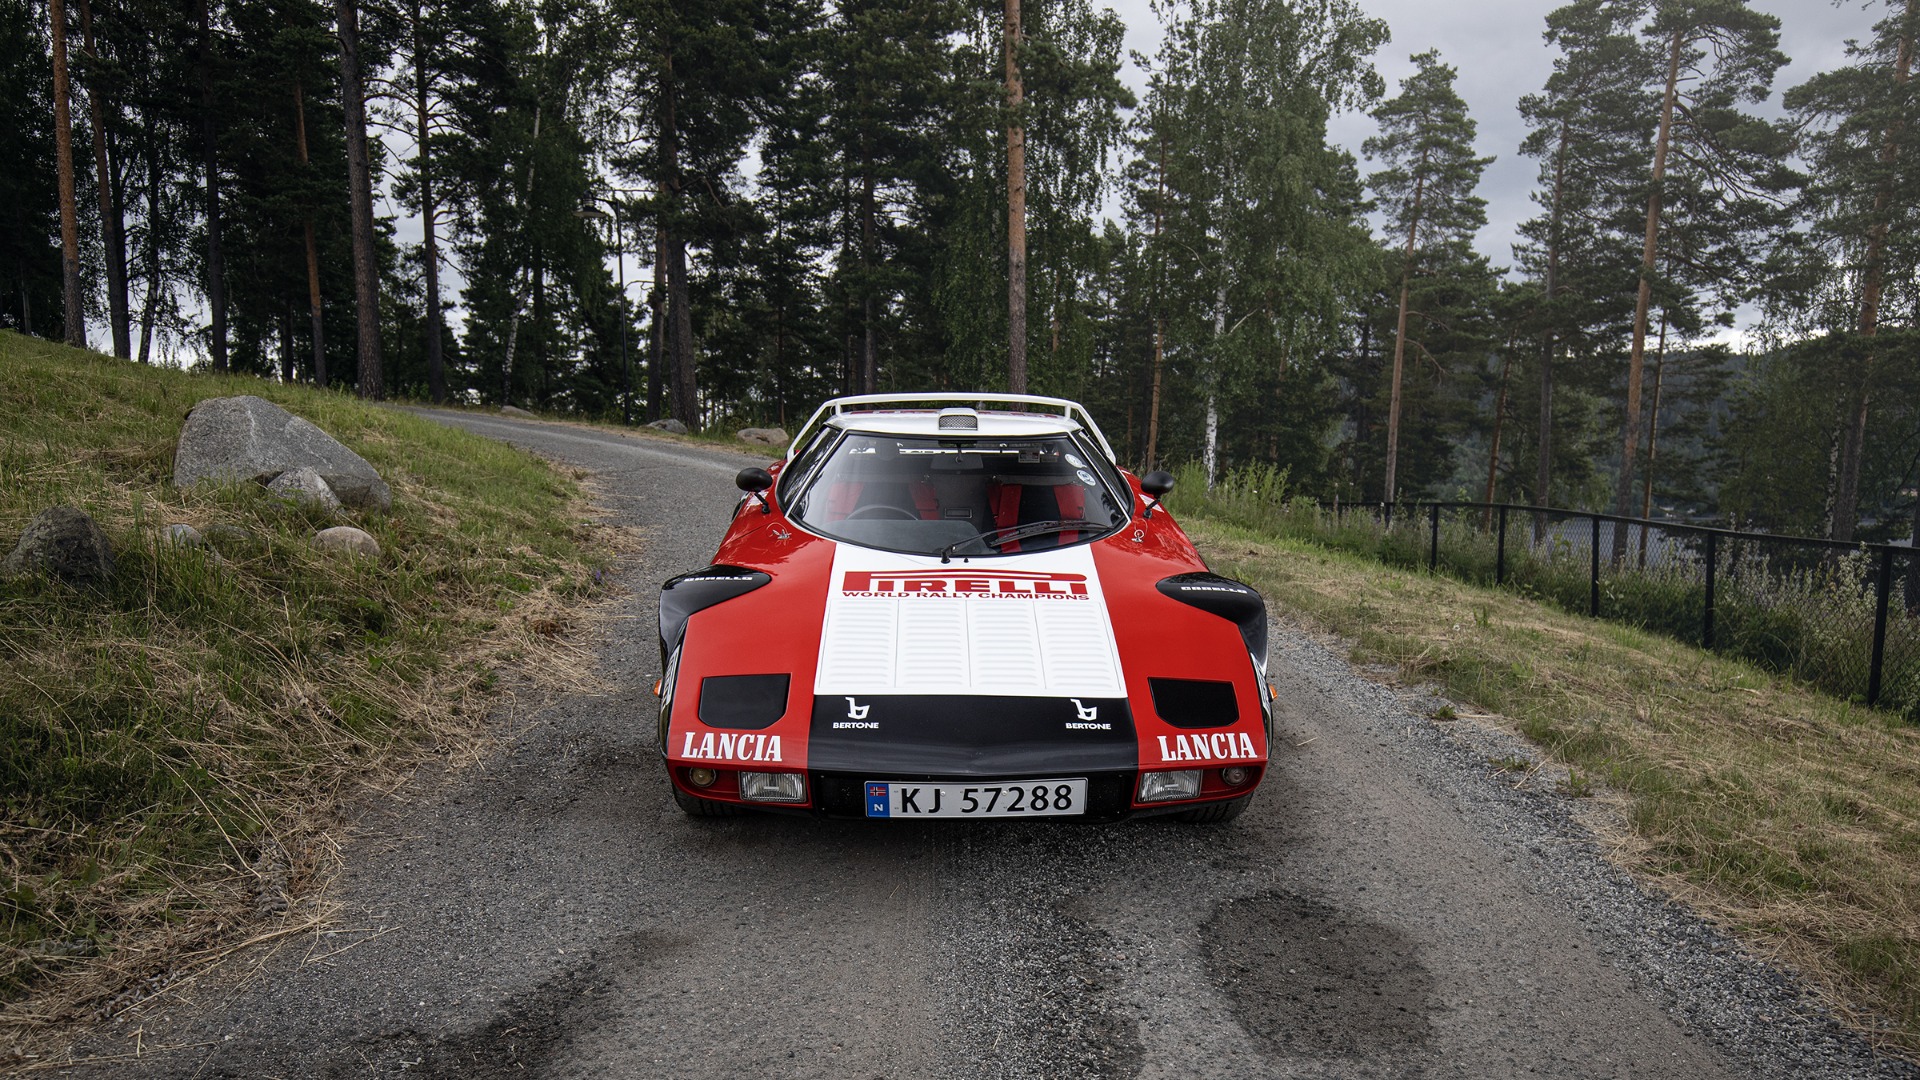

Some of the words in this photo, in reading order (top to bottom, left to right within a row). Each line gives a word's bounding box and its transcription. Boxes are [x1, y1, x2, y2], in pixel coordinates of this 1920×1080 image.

[842, 568, 1088, 595] PIRELLI
[983, 592, 1090, 600] CHAMPIONS
[1065, 722, 1112, 730] BERTONE
[681, 731, 782, 762] LANCIA
[1157, 732, 1258, 762] LANCIA
[873, 803, 884, 812] N
[901, 788, 942, 813] KJ
[961, 784, 1073, 813] 57288
